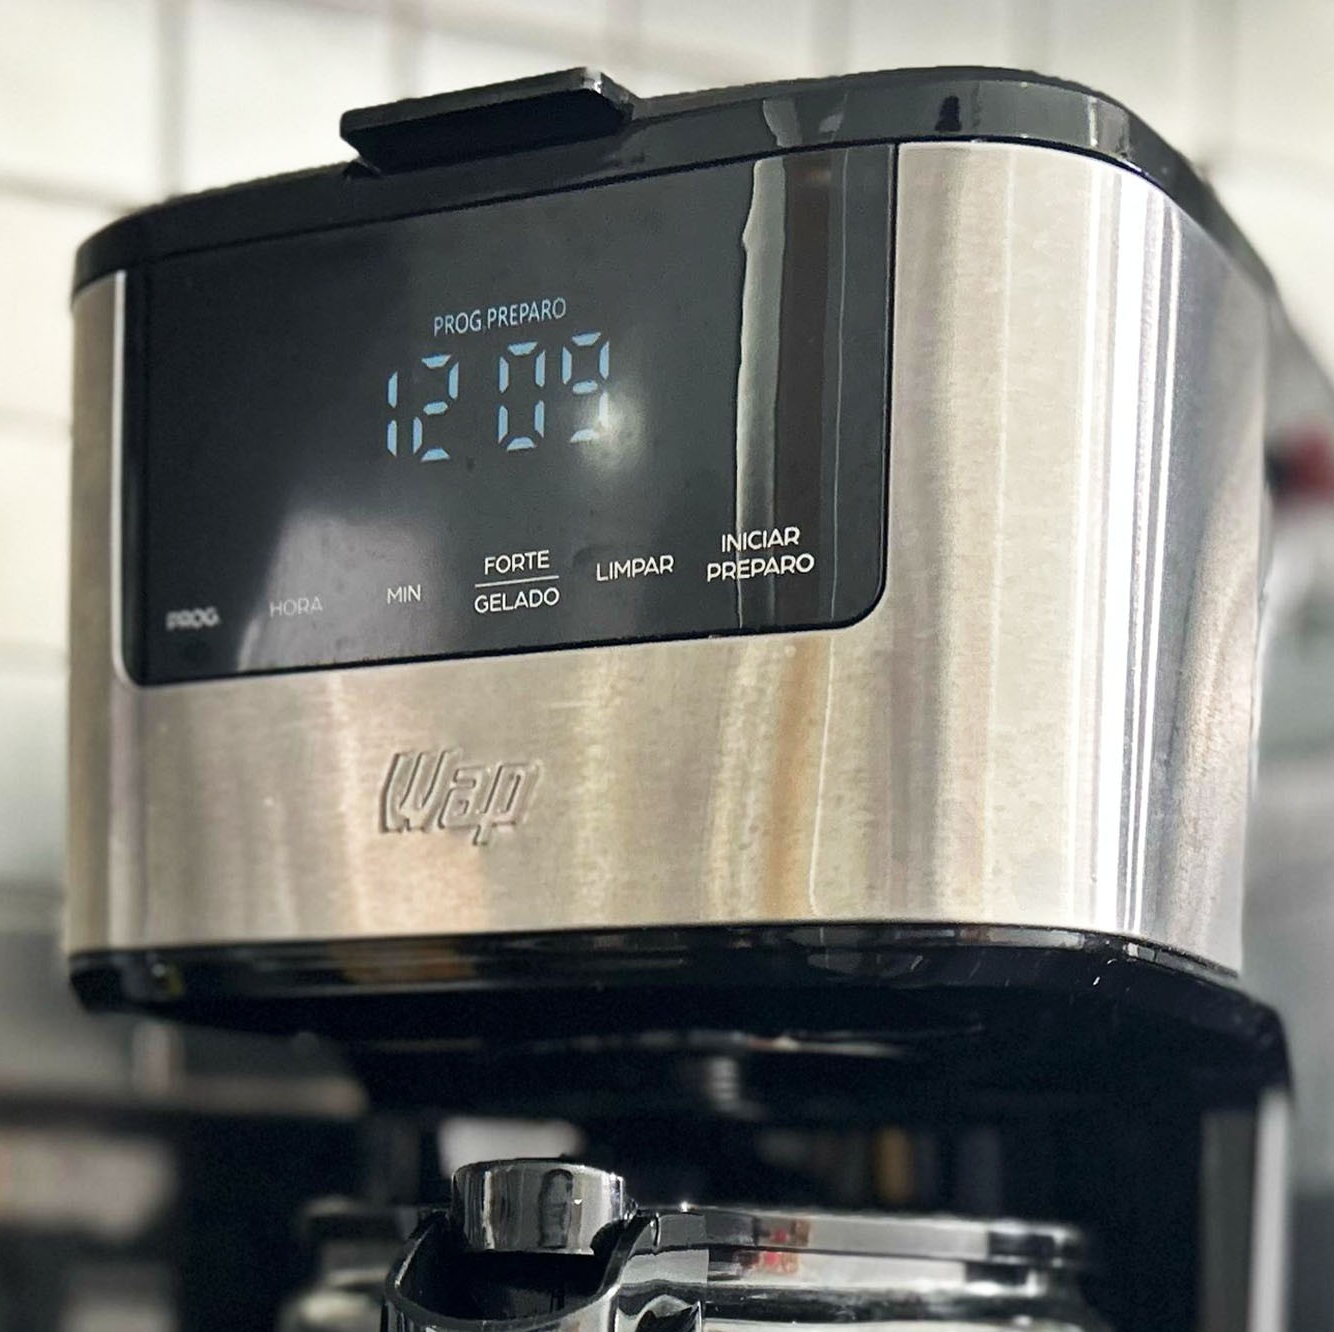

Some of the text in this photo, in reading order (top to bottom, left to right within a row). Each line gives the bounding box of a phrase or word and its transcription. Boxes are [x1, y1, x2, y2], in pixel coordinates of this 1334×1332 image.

[433, 297, 567, 337] PROG PREPARO
[721, 526, 800, 552] INICIAR
[484, 550, 550, 575] FORTE
[596, 555, 675, 582] LIMPAR
[706, 552, 815, 582] PREPARO
[269, 595, 323, 618] HORA
[386, 584, 422, 605] MIN
[474, 587, 560, 614] GELADO
